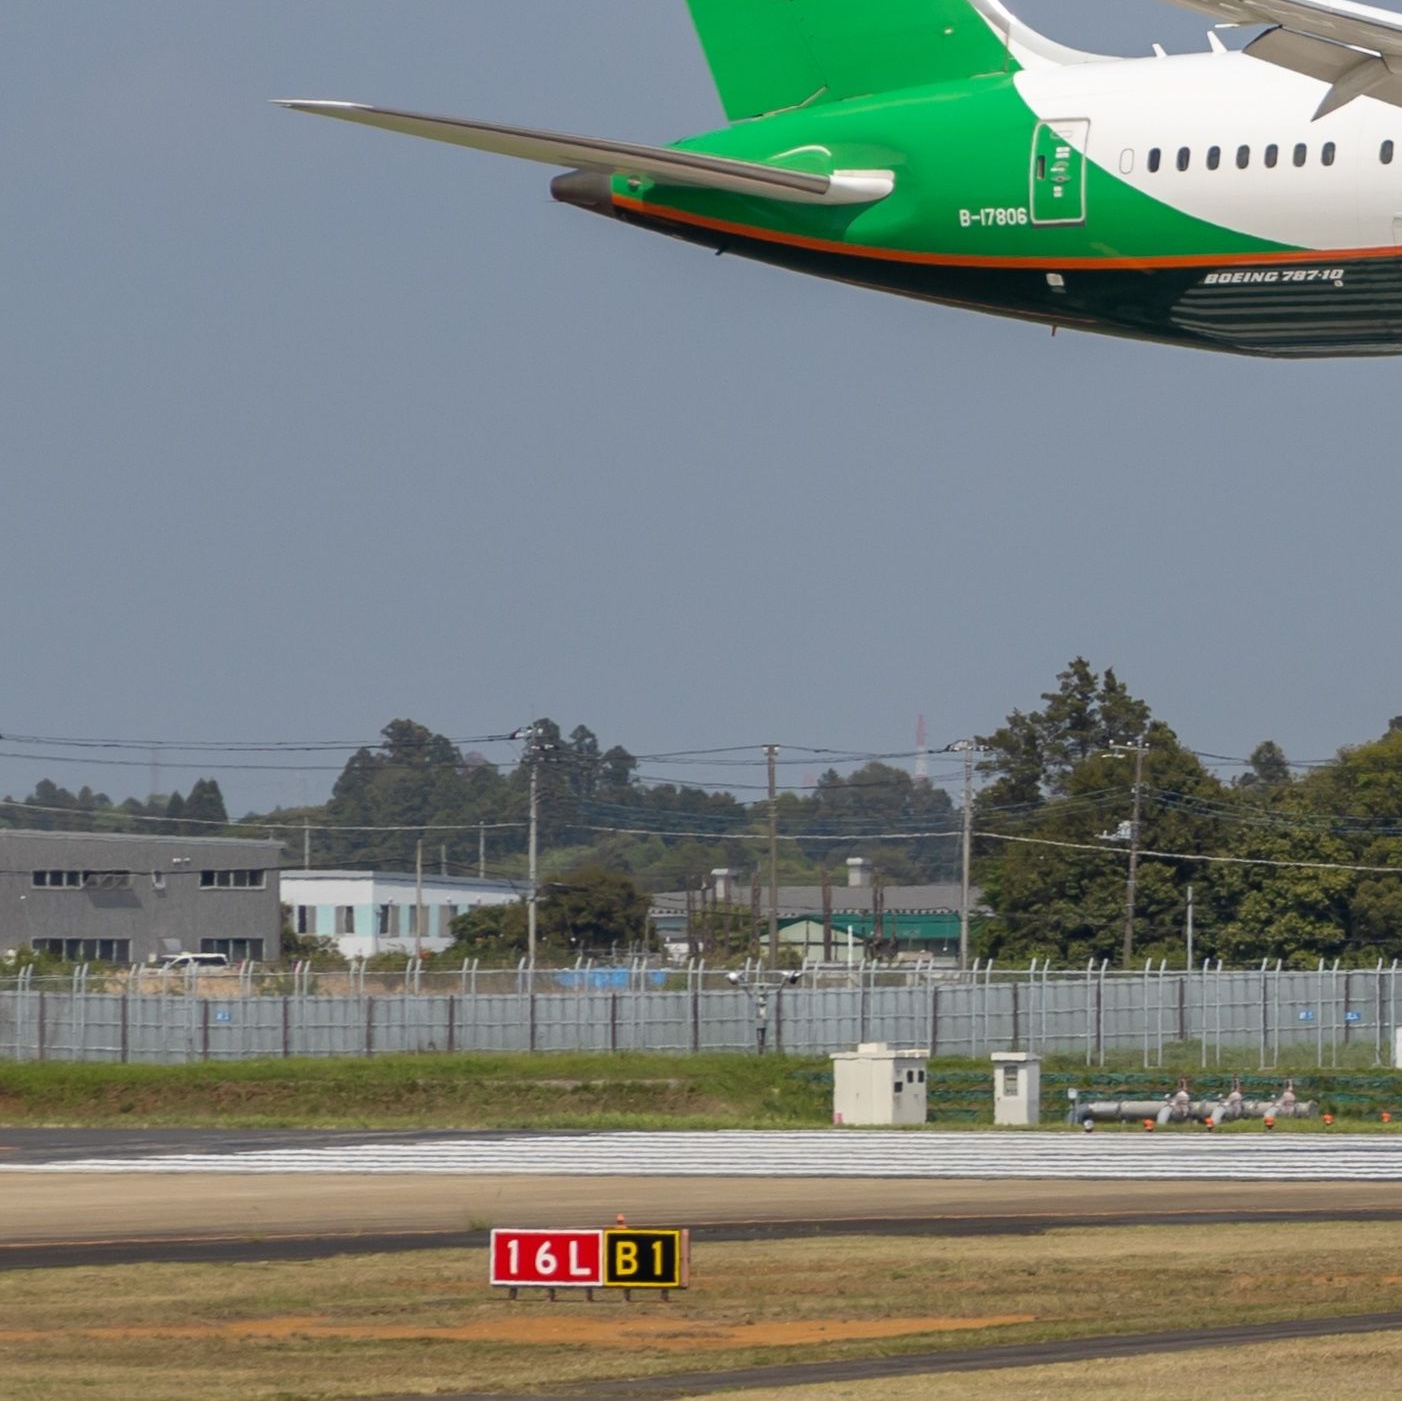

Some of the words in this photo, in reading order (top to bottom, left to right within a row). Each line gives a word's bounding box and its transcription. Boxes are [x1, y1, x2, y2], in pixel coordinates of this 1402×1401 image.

[959, 208, 1028, 227] B-17806
[1203, 271, 1279, 284] BOEING
[1281, 268, 1345, 282] 787-10
[507, 1239, 592, 1275] 16L
[615, 1240, 663, 1276] B1
